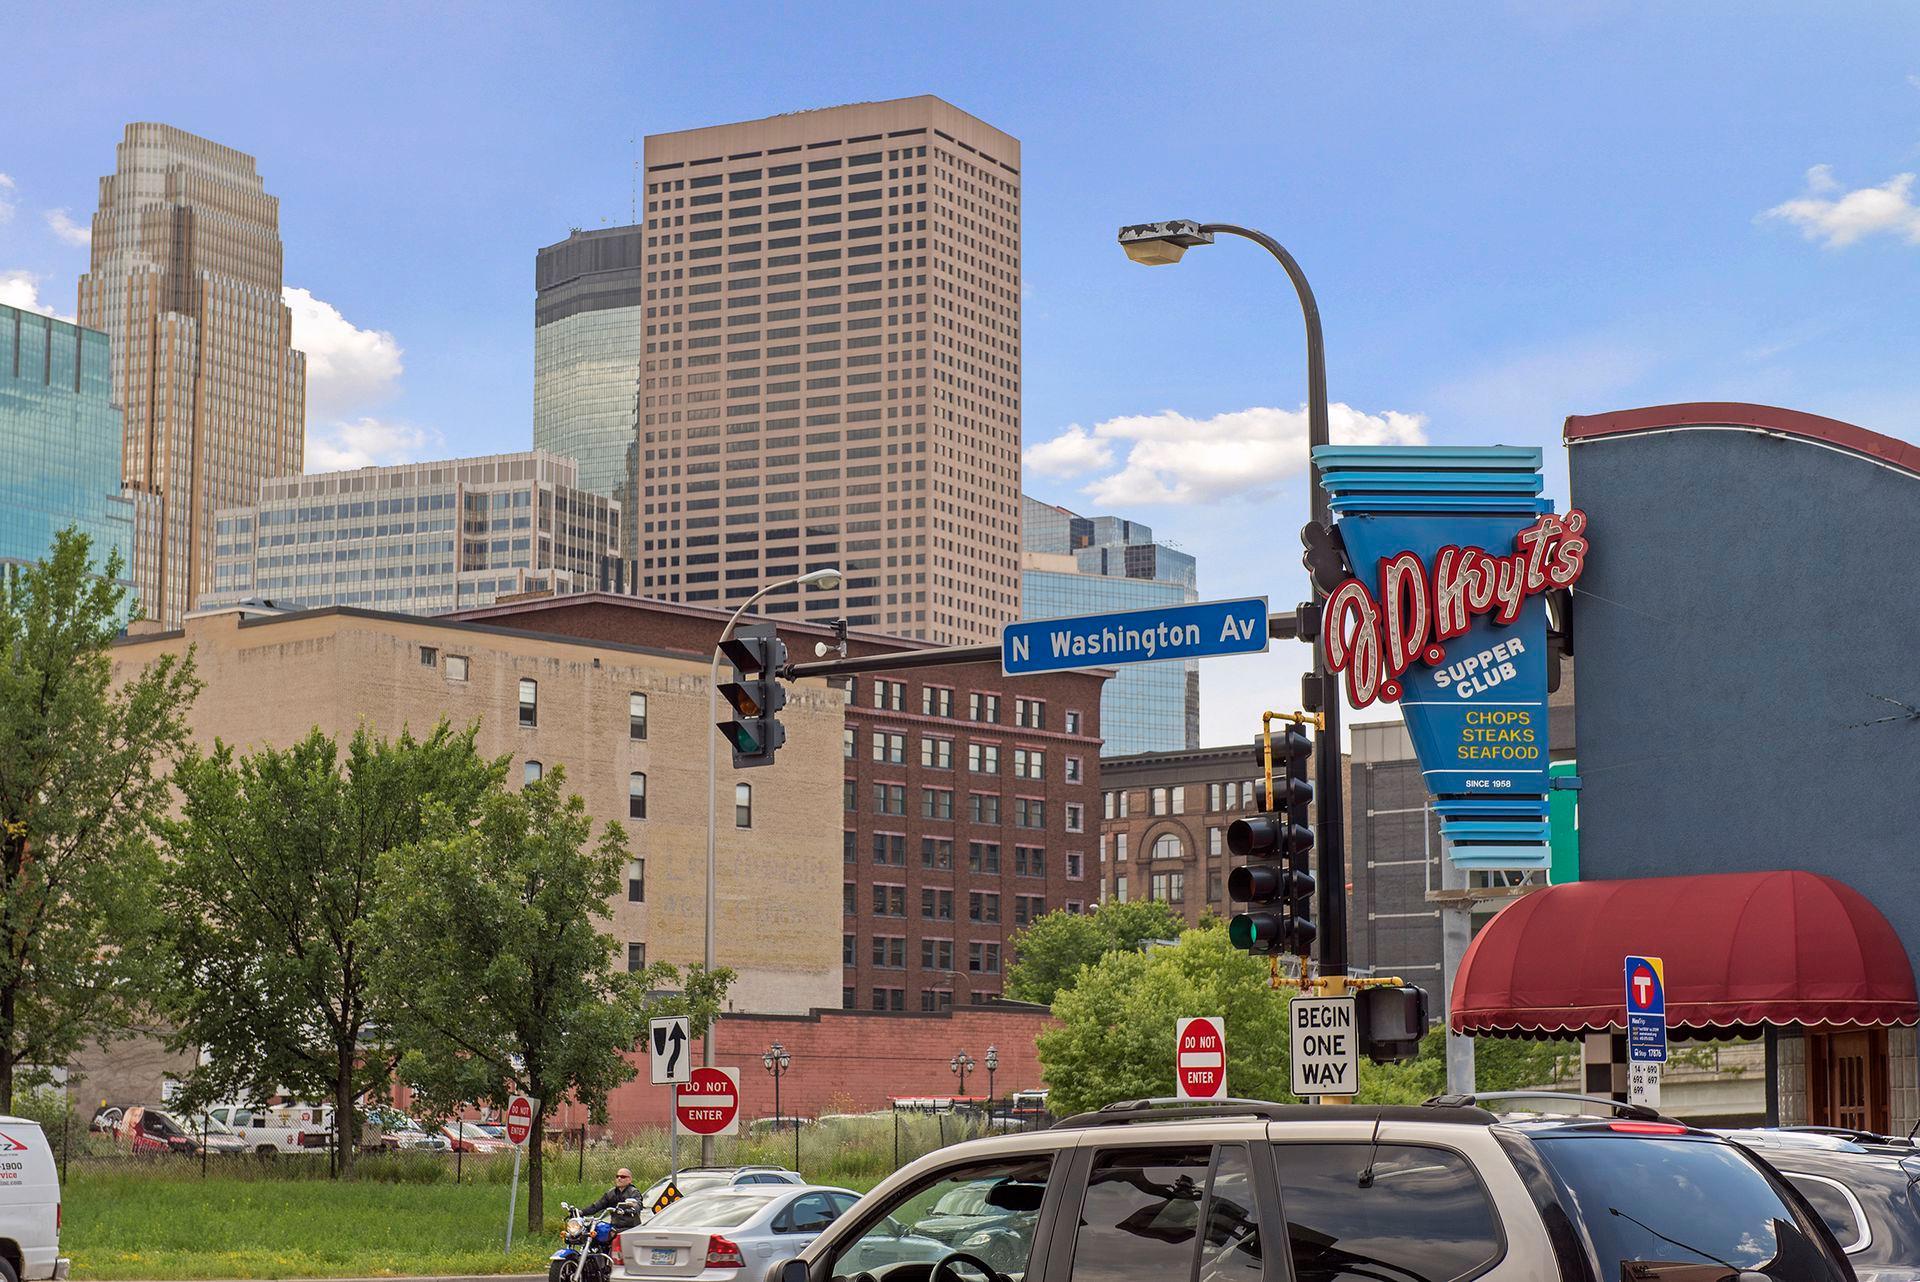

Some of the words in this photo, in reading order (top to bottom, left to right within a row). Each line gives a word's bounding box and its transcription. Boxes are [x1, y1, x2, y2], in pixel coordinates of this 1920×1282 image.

[1433, 511, 1587, 640] Hoyt's
[1012, 635, 1029, 662] N
[1051, 621, 1200, 658] Washington
[1220, 614, 1255, 642] Av
[1433, 637, 1526, 688] SUPPER
[1456, 661, 1517, 698] CLUB
[1466, 711, 1530, 725] CHOPS
[1462, 728, 1535, 742] STEAKS
[1457, 745, 1539, 759] SEAFOOD
[1465, 780, 1490, 788] SINCE
[1492, 780, 1511, 788] 1958
[1298, 1006, 1350, 1028] BEGIN
[1185, 1036, 1196, 1048] DO
[1200, 1036, 1215, 1048] NOT
[1303, 1035, 1346, 1056] ONE
[1302, 1062, 1348, 1085] WAY
[1634, 1065, 1641, 1073] 14
[1647, 1066, 1657, 1074] 690
[1187, 1072, 1213, 1084] ENTER
[1633, 1076, 1643, 1084] 692
[1647, 1076, 1658, 1084] 697
[685, 1082, 700, 1092] DO
[706, 1082, 728, 1092] NOT
[1633, 1086, 1643, 1094] 699
[511, 1105, 519, 1114] DO
[520, 1106, 529, 1115] NOT
[688, 1110, 723, 1120] ENTER
[510, 1126, 526, 1136] ENTER
